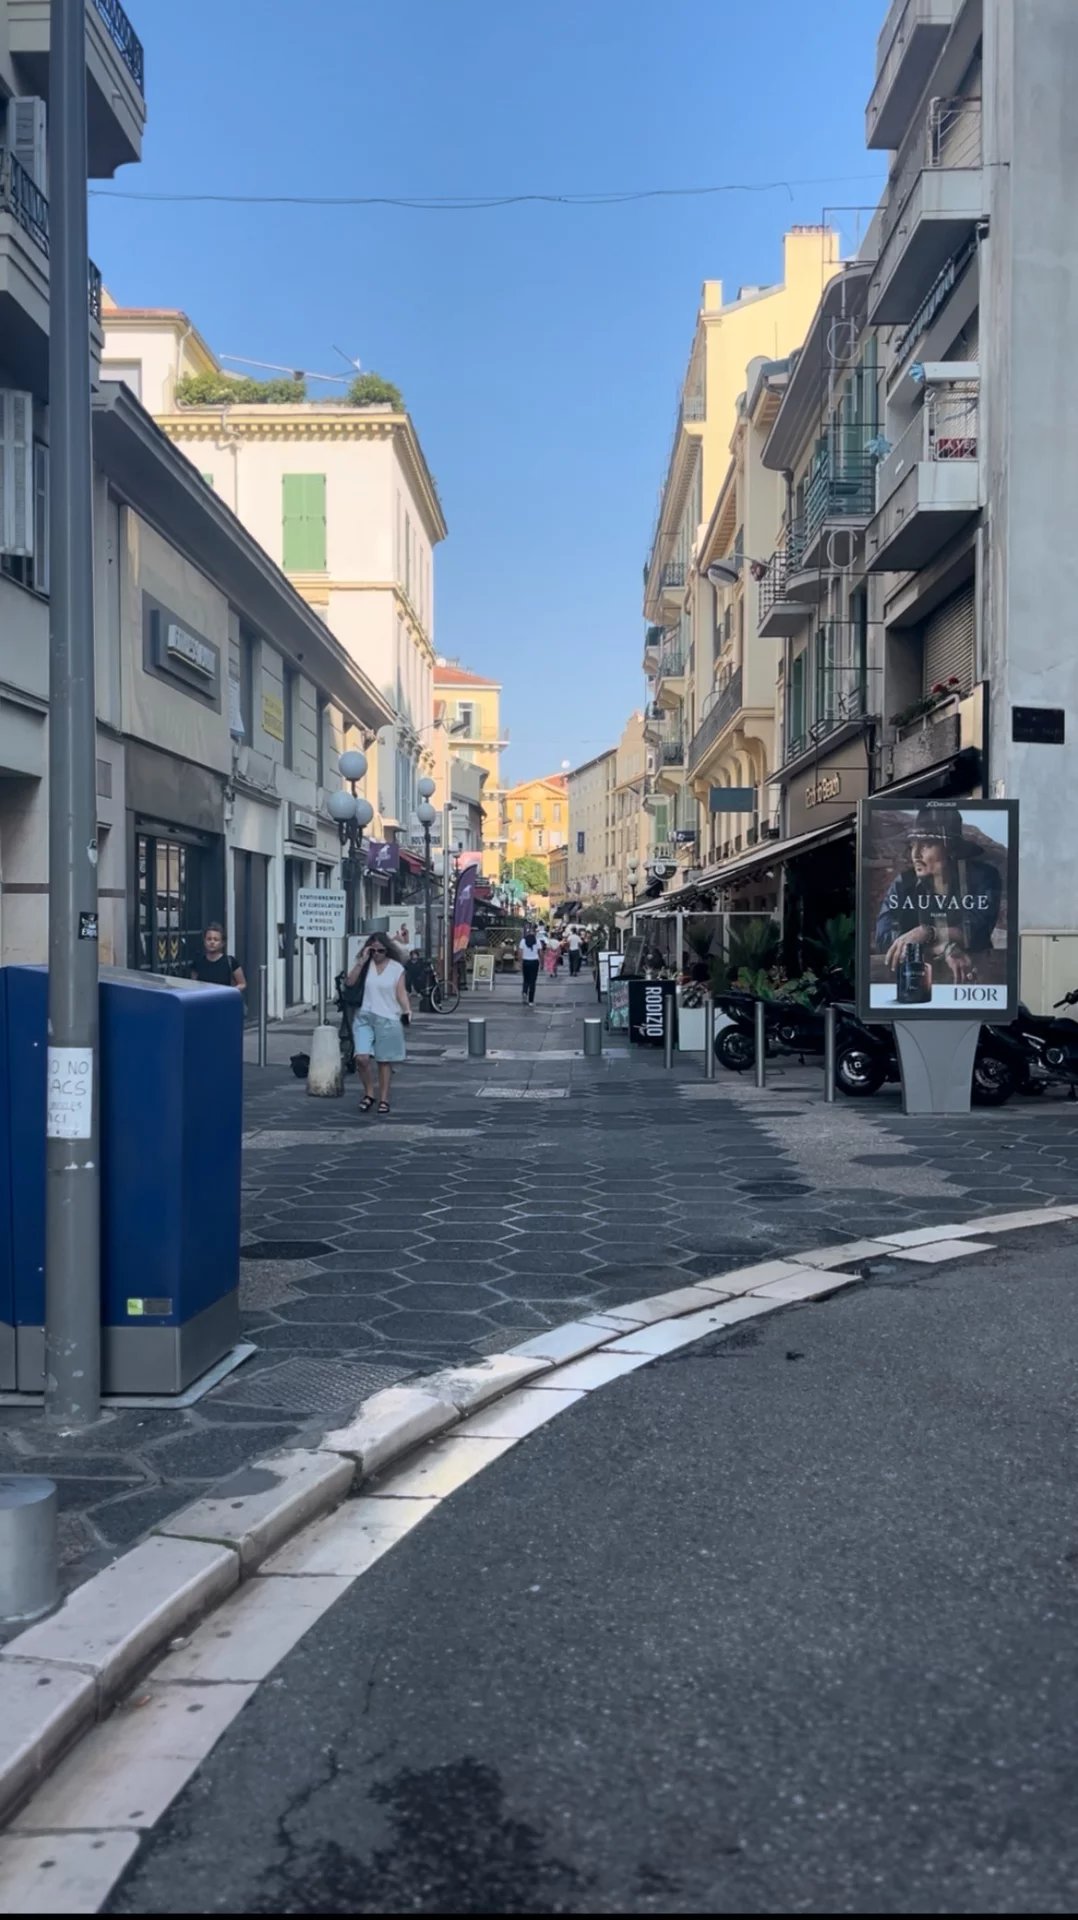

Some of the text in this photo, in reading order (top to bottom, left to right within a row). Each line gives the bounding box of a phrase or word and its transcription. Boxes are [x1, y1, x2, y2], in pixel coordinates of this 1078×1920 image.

[889, 894, 989, 910] SAUVAGE
[954, 987, 998, 1001] DIOR
[645, 986, 664, 1036] RODIZIO
[68, 1060, 89, 1075] NO
